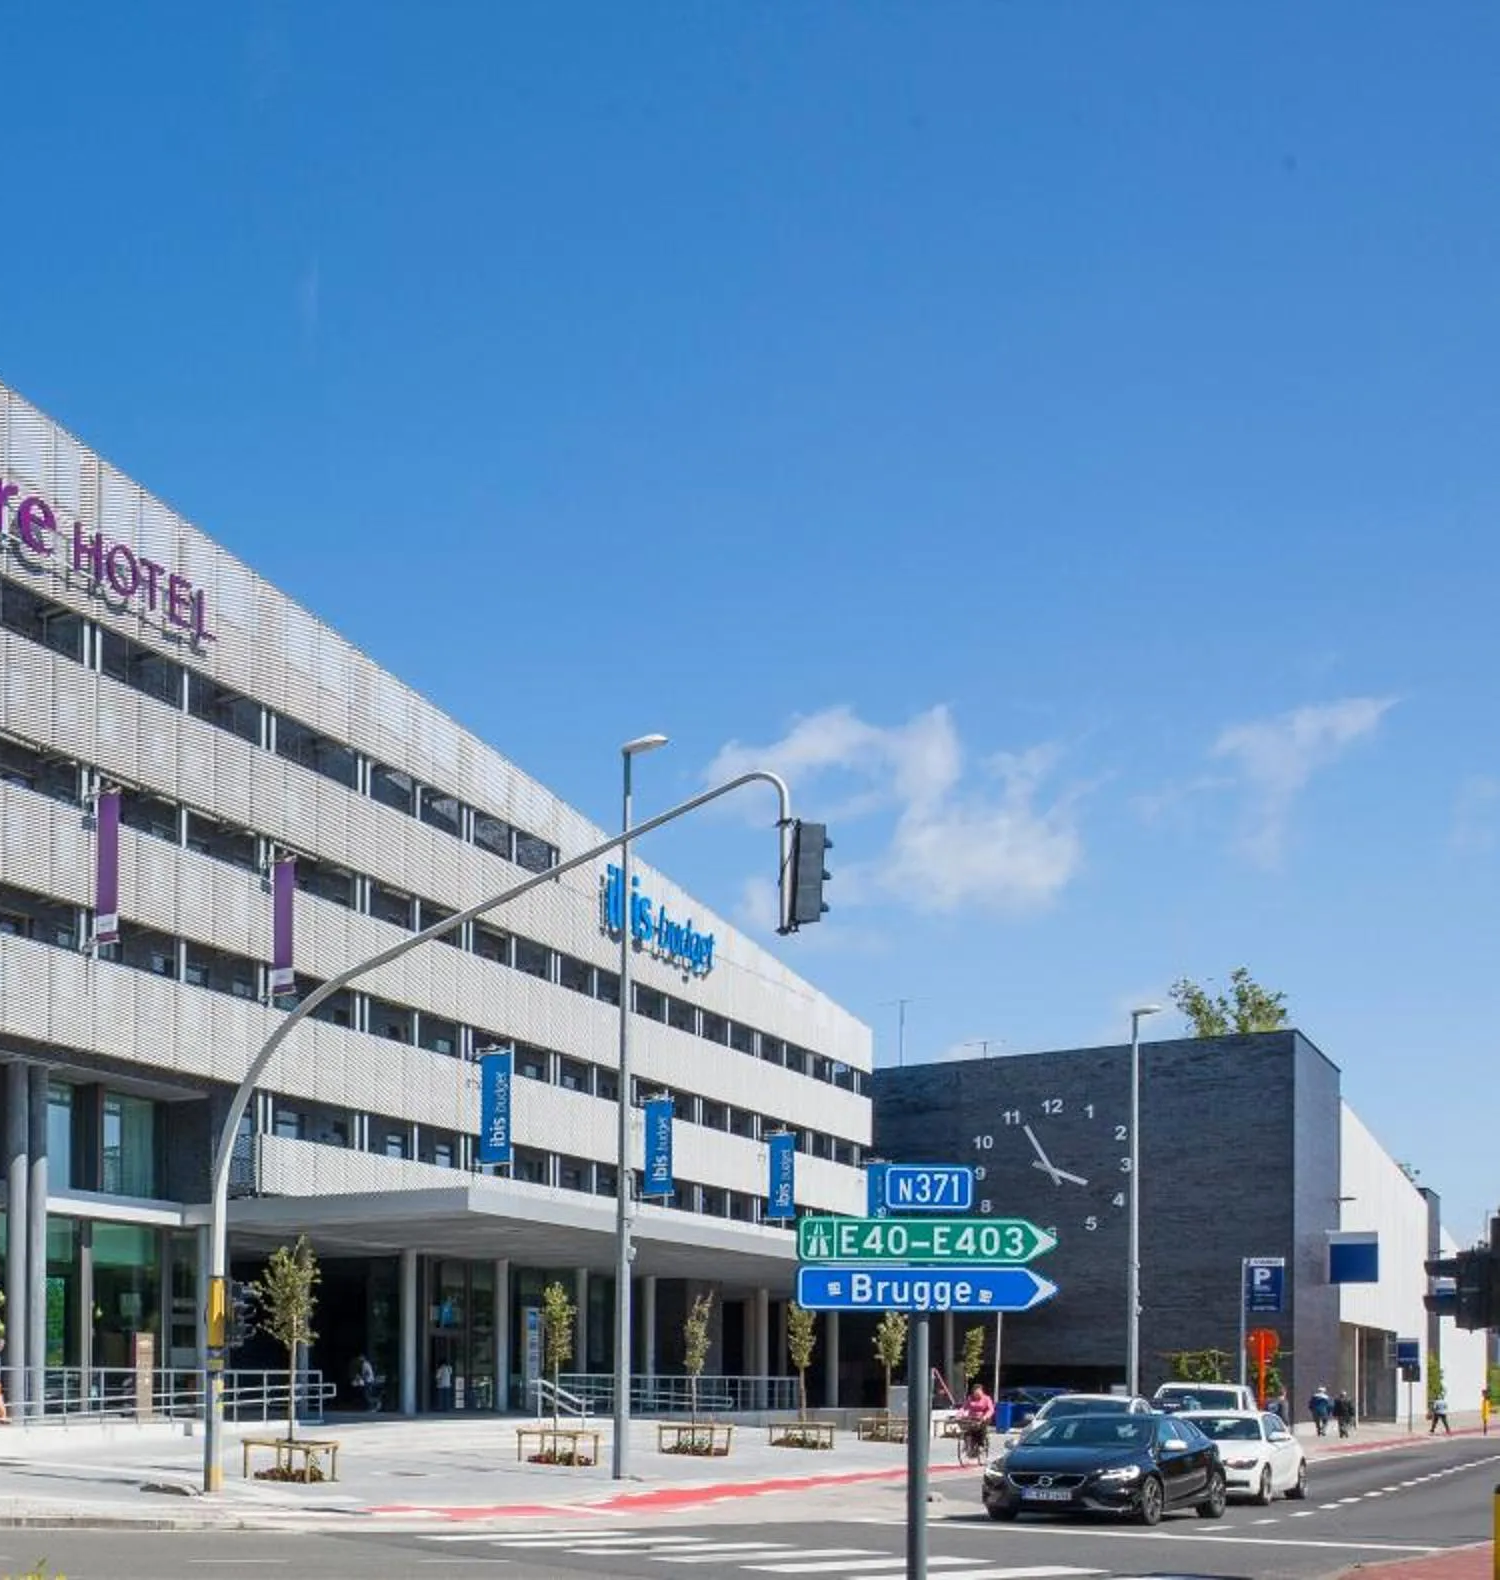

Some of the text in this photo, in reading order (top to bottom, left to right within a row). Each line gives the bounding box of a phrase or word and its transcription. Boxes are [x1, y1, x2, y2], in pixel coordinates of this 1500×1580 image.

[73, 521, 217, 642] HOTEL
[1041, 1099, 1064, 1114] 12
[1084, 1104, 1094, 1119] 1
[1002, 1110, 1021, 1125] 11
[489, 1117, 507, 1148] ibis
[1114, 1126, 1127, 1141] 2
[973, 1136, 994, 1149] 10
[1119, 1157, 1132, 1172] 3
[974, 1167, 986, 1181] 9
[899, 1174, 960, 1202] N371
[980, 1200, 992, 1213] 8
[1112, 1192, 1125, 1207] 4
[1085, 1216, 1097, 1231] 5
[1254, 1268, 1271, 1285] P
[851, 1273, 972, 1311] Brugge
